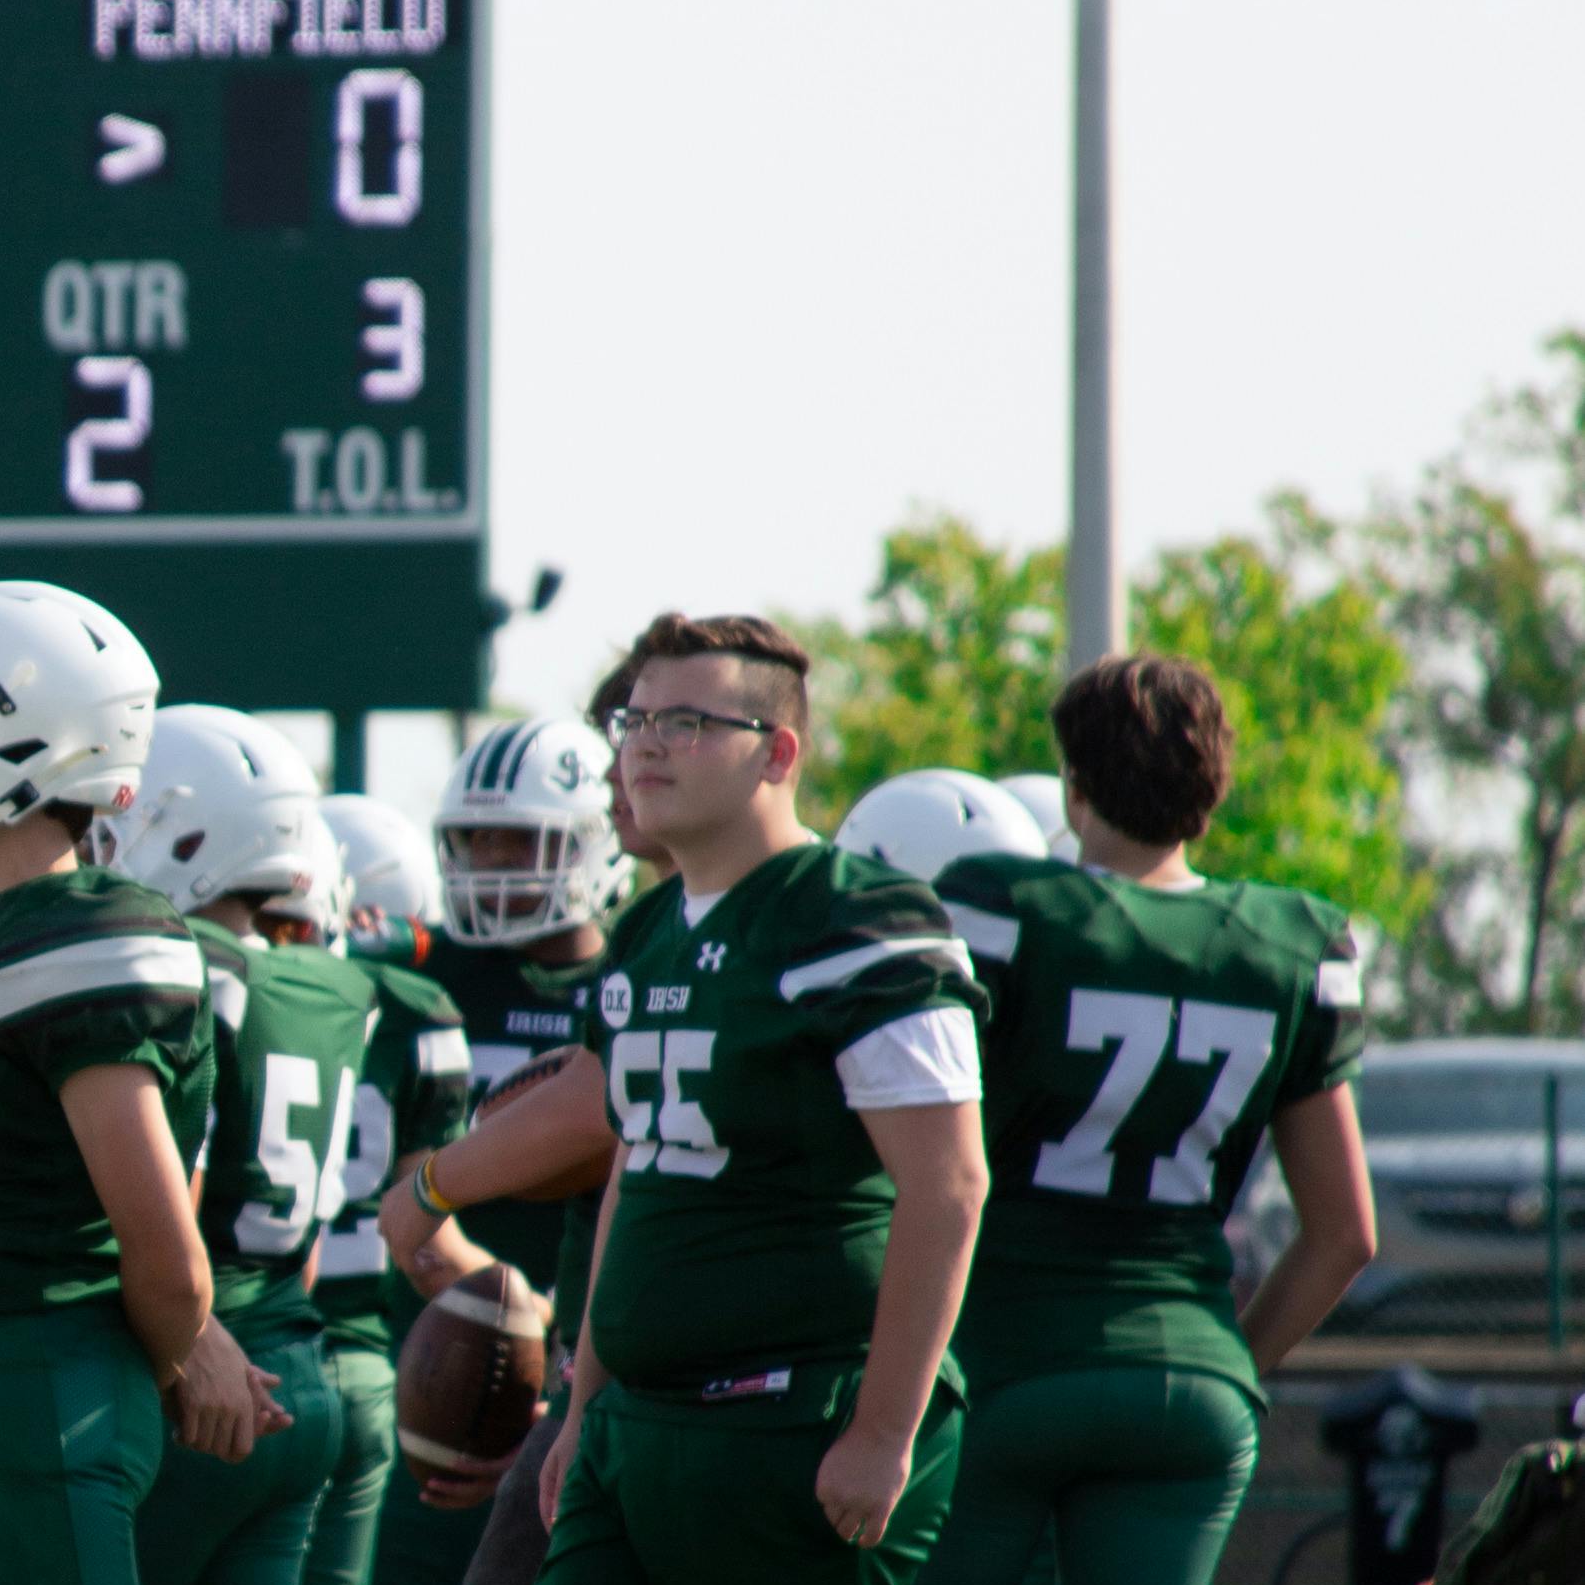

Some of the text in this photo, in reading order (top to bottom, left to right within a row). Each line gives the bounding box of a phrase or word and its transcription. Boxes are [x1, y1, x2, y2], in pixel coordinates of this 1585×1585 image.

[336, 69, 424, 226] 0
[42, 259, 188, 352] QTR
[360, 276, 425, 402] 3
[63, 355, 154, 512] 2
[283, 425, 460, 512] T.O.L.
[645, 985, 691, 1014] IRISH
[609, 1028, 730, 1180] 55
[1032, 987, 1278, 1206] 77
